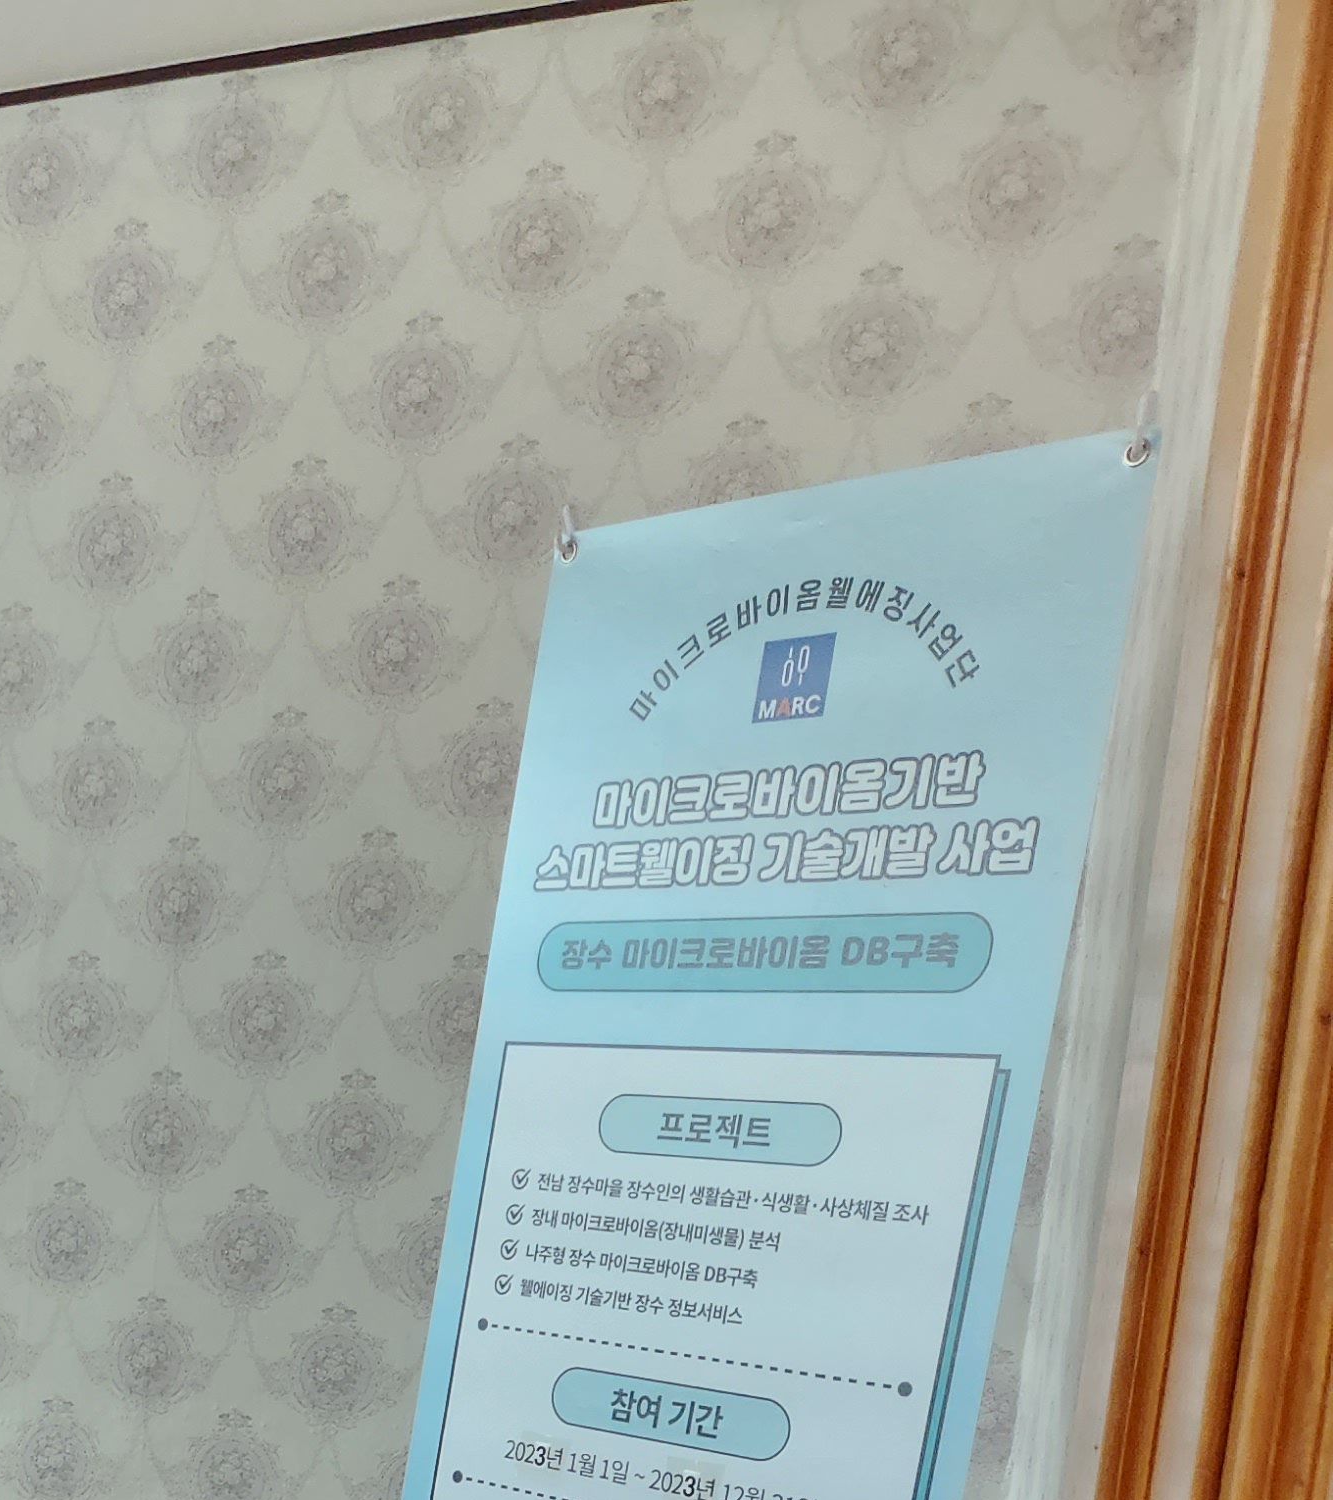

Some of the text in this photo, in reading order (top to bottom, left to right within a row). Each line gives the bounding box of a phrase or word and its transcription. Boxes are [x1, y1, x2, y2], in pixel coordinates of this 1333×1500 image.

[629, 576, 980, 722] 마이크로바이옴웰에징사업단
[758, 694, 822, 720] MARC
[591, 749, 985, 829] 마이크로바이옴기반
[531, 815, 1040, 891] 스마트웰이징 기술개발 사업
[560, 931, 960, 970] 장수 마이크로바이옴 DB구축
[655, 1111, 771, 1149] 프로젝트
[536, 1171, 565, 1193] 전남
[566, 1174, 624, 1198] 장수마을
[625, 1179, 686, 1204] 장수인의
[890, 1202, 930, 1226] 조사
[530, 1207, 782, 1252] 장내 마이크로바이옴(장내미생물) 분석
[524, 1242, 758, 1290] 나주형 장수 마이크로바이옴 DB구축
[519, 1277, 743, 1325] 웰에이징 기술기반 장수 정보서비스
[610, 1387, 724, 1440] 참여 기간
[503, 1438, 564, 1472] 2023년
[565, 1451, 597, 1479] 1월
[598, 1458, 630, 1486] 1일
